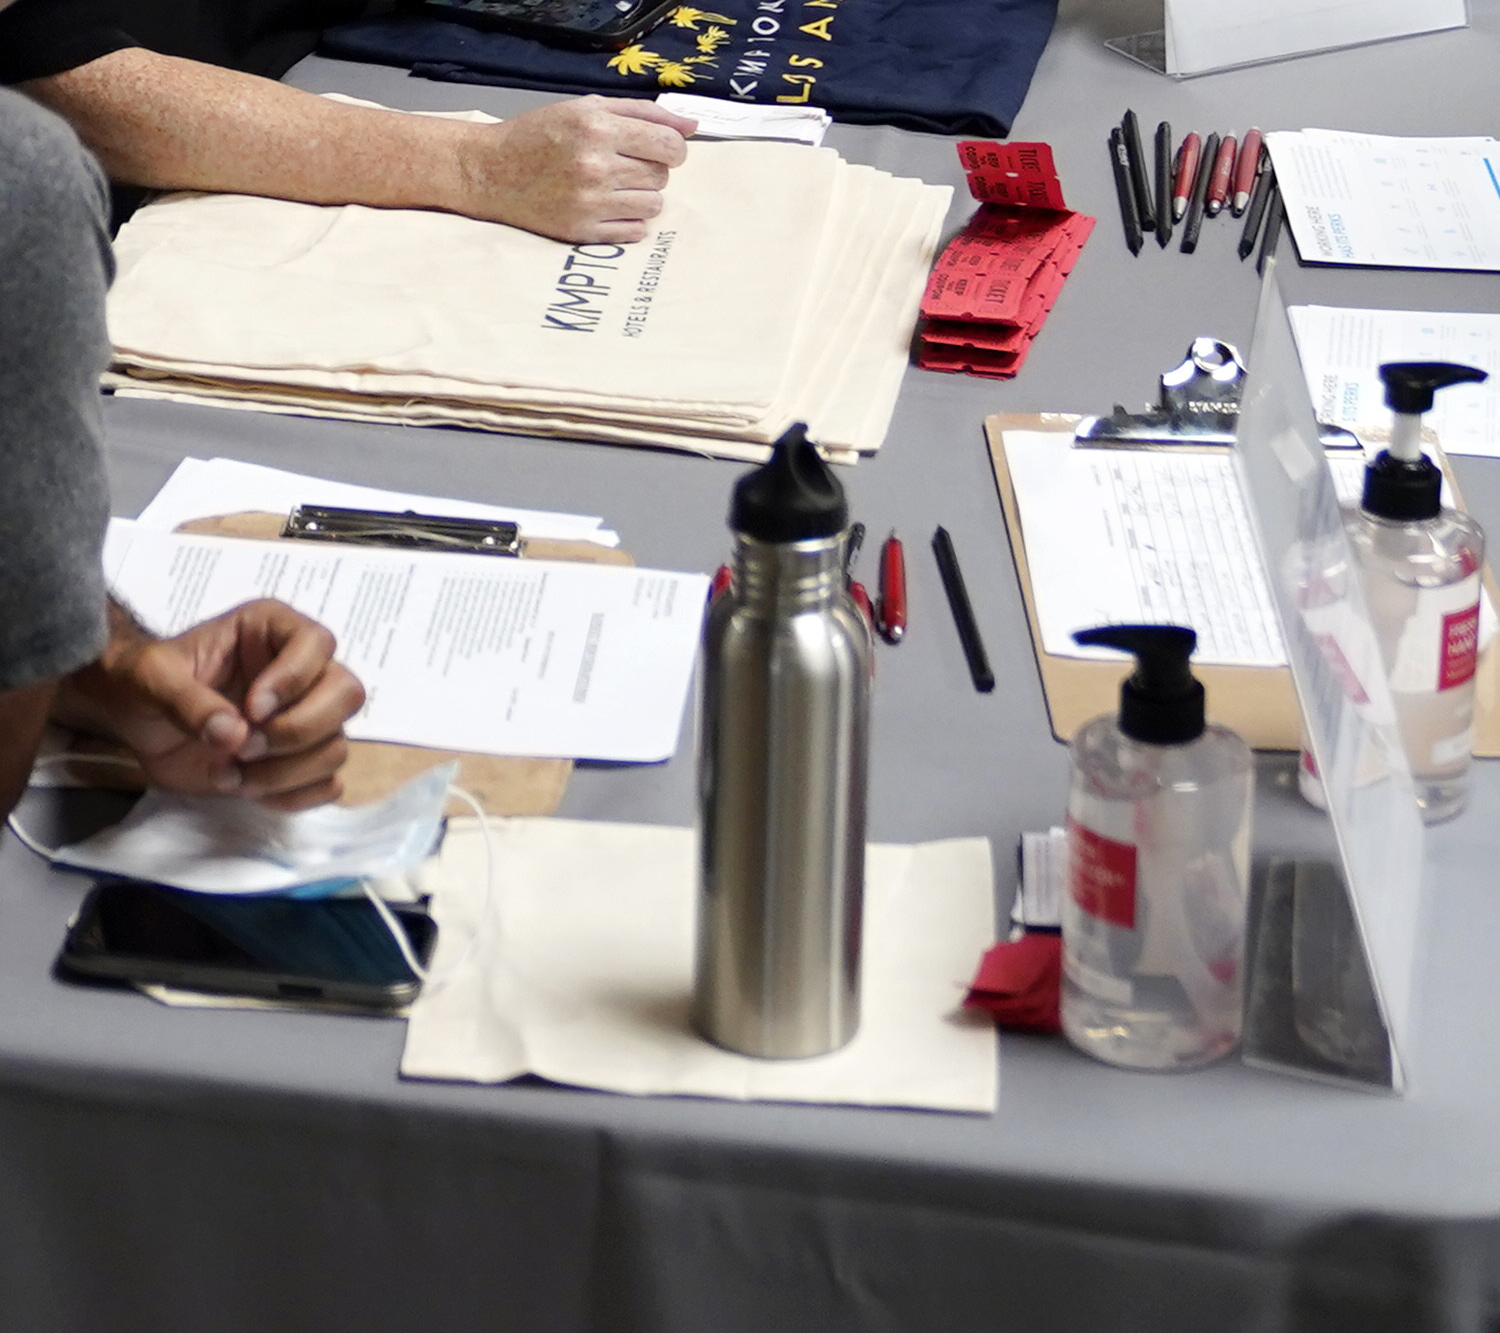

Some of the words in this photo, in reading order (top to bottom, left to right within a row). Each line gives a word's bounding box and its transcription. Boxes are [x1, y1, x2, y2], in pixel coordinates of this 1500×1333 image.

[541, 243, 625, 333] KIMPTO
[622, 305, 650, 338] HOTELS
[637, 231, 677, 294] RESTAURANTS
